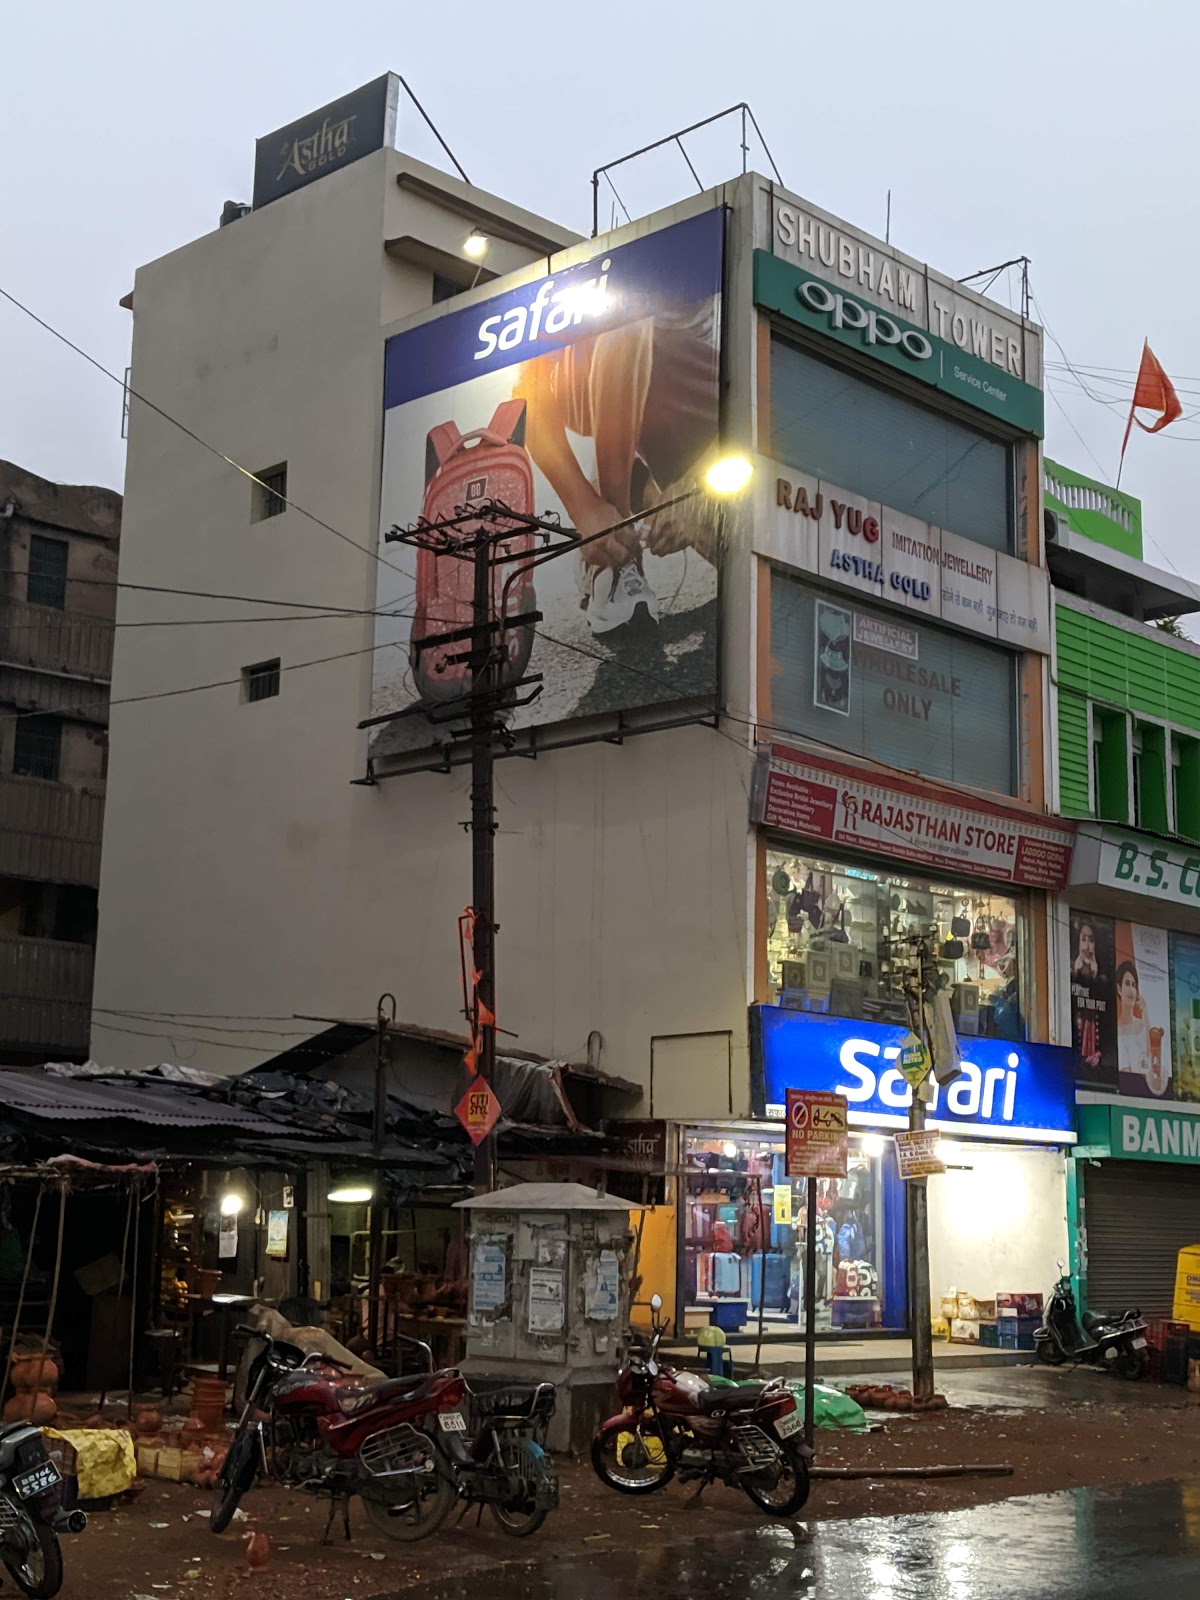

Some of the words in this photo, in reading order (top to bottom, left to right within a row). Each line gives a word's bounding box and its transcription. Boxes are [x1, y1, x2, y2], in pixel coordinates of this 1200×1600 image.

[276, 114, 357, 181] Astha
[308, 146, 346, 171] GOLD
[777, 206, 916, 313] SHUBHAM
[934, 300, 1021, 377] TOWER
[953, 366, 981, 389] Service
[982, 381, 1007, 402] Center
[777, 478, 824, 520] RAJ
[831, 500, 879, 543] YUG
[831, 549, 885, 585] ASTHA
[892, 531, 940, 566] IMITATION
[941, 551, 993, 585] JEWELLERY
[858, 630, 914, 655] JEWELLERY
[859, 617, 912, 643] ARTIFICIAL
[883, 688, 932, 721] ONLY
[861, 799, 961, 844] RAJASTHAN
[965, 826, 1016, 855] STORE
[792, 1129, 804, 1140] NO
